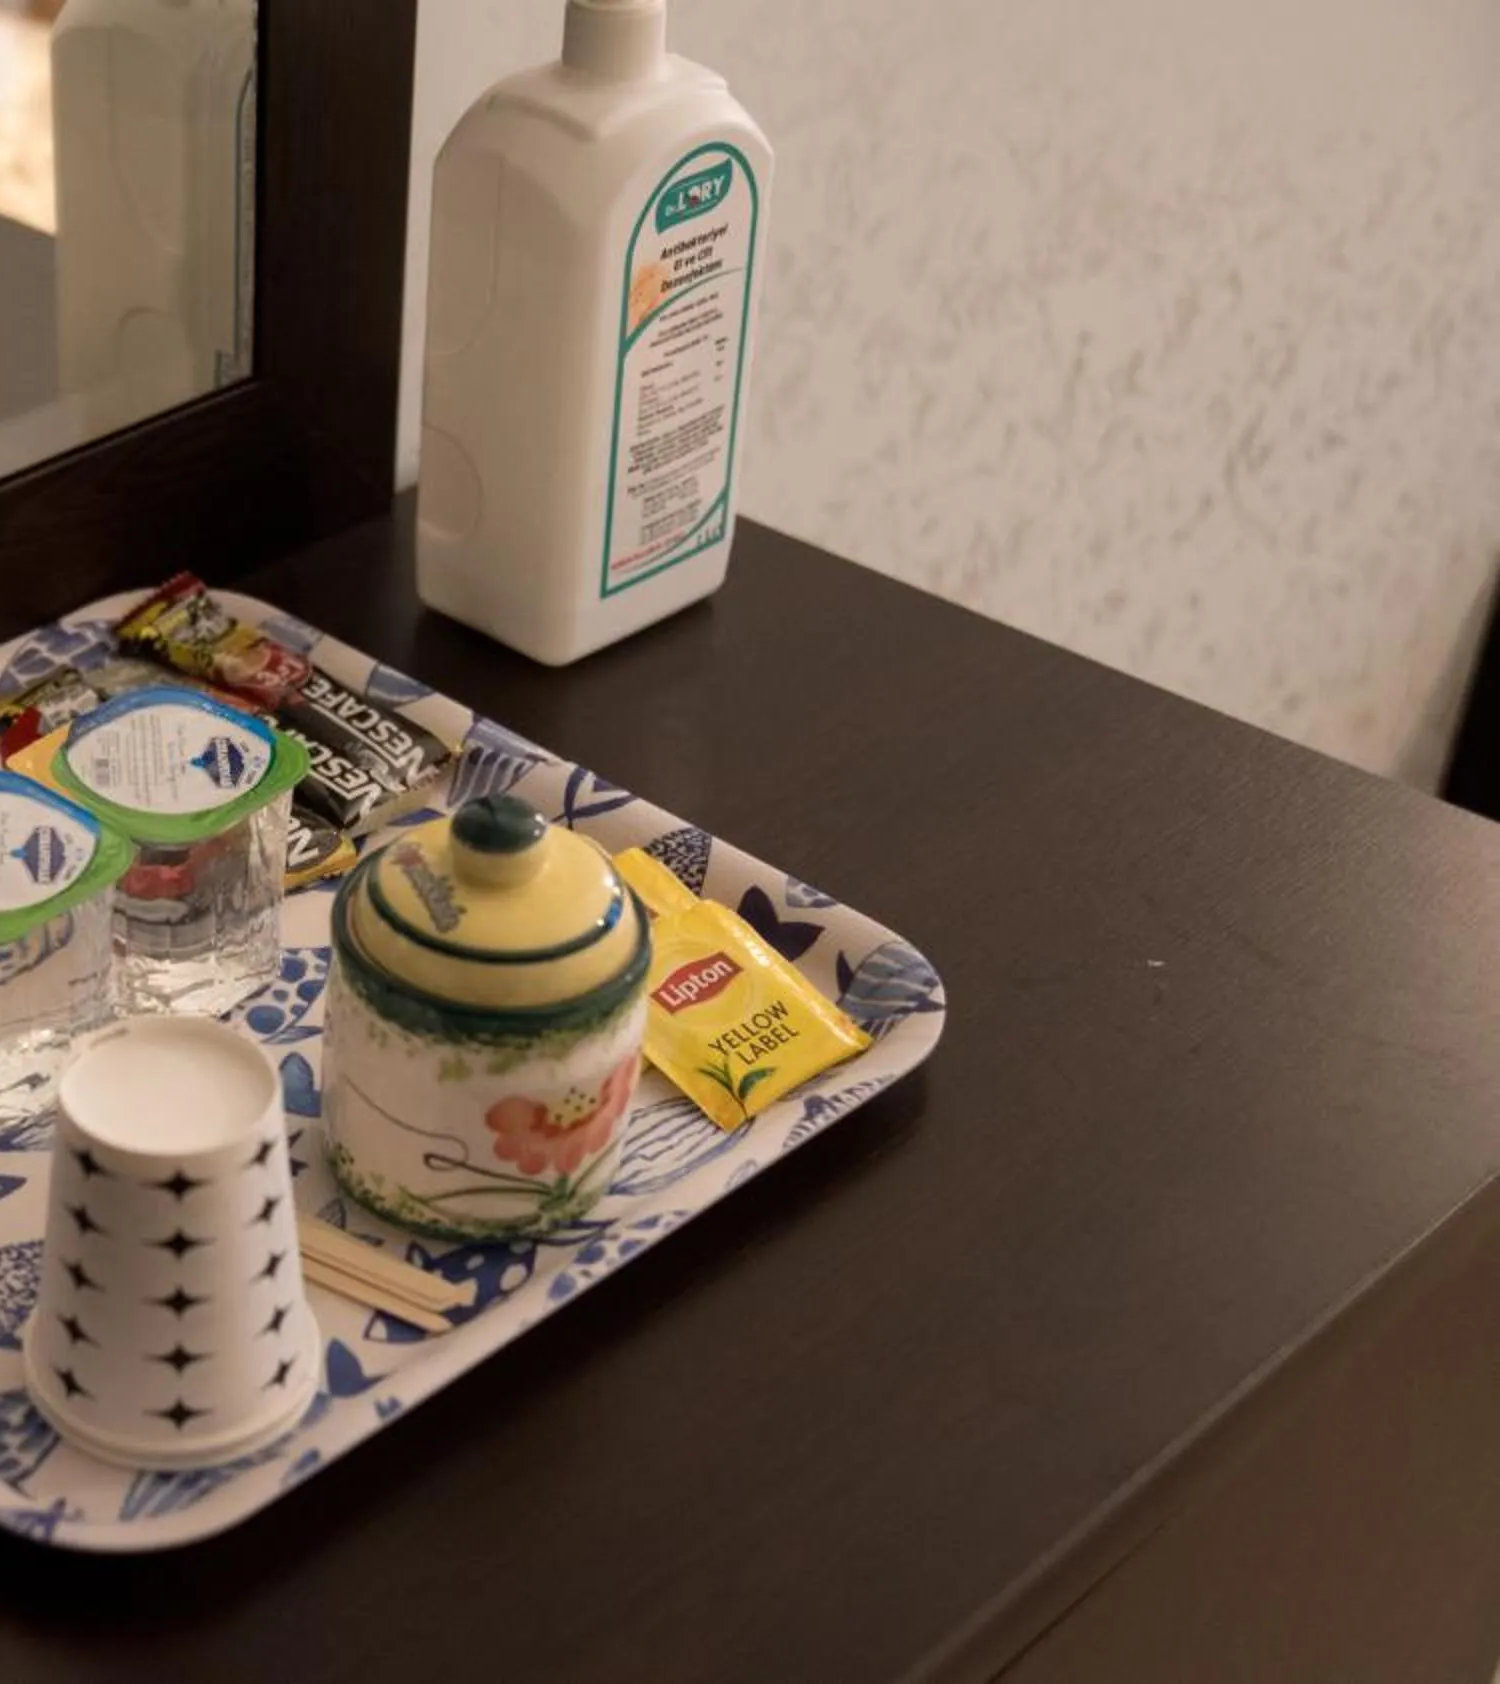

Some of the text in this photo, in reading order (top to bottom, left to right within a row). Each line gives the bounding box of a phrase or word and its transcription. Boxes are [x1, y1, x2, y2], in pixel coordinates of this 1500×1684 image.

[659, 960, 733, 1008] Lipton
[707, 999, 790, 1057] YELLOW
[735, 1022, 801, 1066] LABEL
